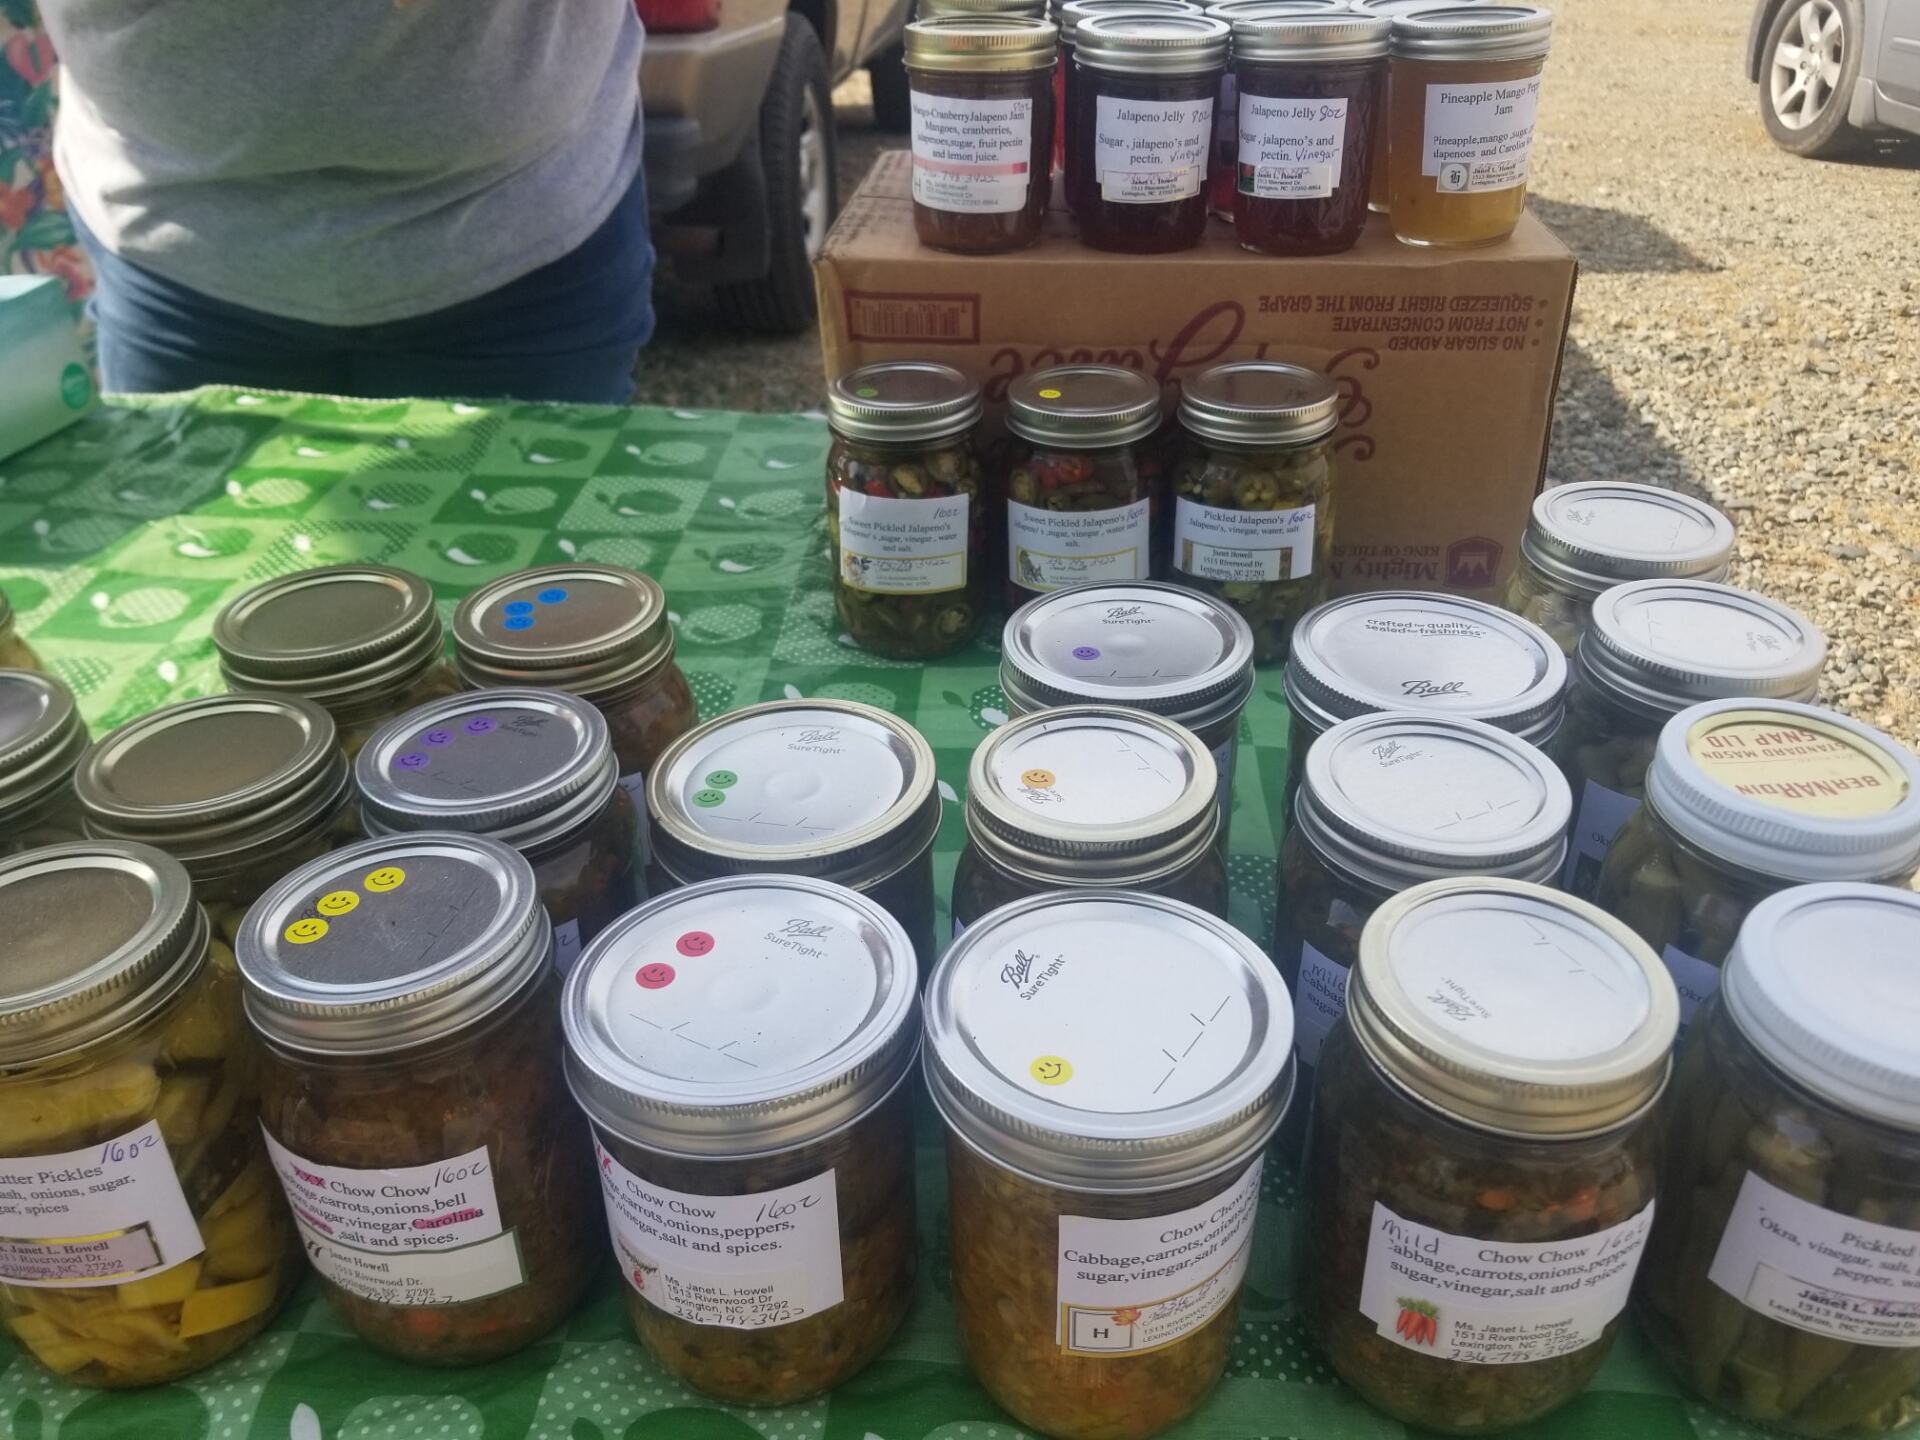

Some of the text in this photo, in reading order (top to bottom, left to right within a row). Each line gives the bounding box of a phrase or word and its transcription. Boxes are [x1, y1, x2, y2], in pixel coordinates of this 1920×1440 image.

[1441, 86, 1526, 105] Pineapple Mango
[1009, 110, 1025, 120] Jam
[1117, 109, 1185, 124] Jalapeno Jelly
[1250, 103, 1317, 121] Jalapeno Jelly
[1494, 105, 1513, 116] Jam
[962, 124, 1012, 135] cranberries,
[979, 139, 1022, 151] fruit pectin
[1185, 135, 1199, 147] and
[1316, 135, 1334, 146] and
[947, 150, 973, 161] lemon
[1261, 150, 1292, 161] pectin.
[1480, 146, 1497, 157] and
[1130, 154, 1163, 166] pectin.
[1259, 296, 1533, 312] SQUEEZED RIGHT FROM THE GRAPE
[1332, 316, 1529, 332] NOT FROM CONCENTRATE
[1388, 336, 1525, 350] NO SUGAR ADDED
[1048, 518, 1080, 527] Pickled
[1082, 514, 1124, 528] Jalapeno's
[1204, 510, 1284, 528] Pickled Jalapeno's
[874, 522, 905, 533] Pickled
[908, 522, 950, 535] Jalapeno's
[1213, 549, 1252, 559] Janet Howell
[1107, 606, 1144, 619] Ball
[1365, 624, 1406, 633] sealed
[1367, 619, 1412, 628] crafted
[1401, 680, 1472, 698] Ball
[1706, 730, 1817, 748] SNAP LID
[1371, 740, 1402, 760] Ball
[1702, 742, 1847, 760] STANDARD MASON
[1736, 775, 1882, 799] BERNARDIN
[779, 919, 833, 937] Ball
[1001, 949, 1034, 990] Ball
[1020, 957, 1066, 1001] SureTight
[37, 1167, 103, 1185] Pickles
[435, 1162, 487, 1188] 16oz
[31, 1187, 85, 1200] onions,
[88, 1175, 136, 1192] sugar,
[330, 1181, 430, 1199] Chow Chow
[626, 1180, 664, 1207] Chow
[669, 1200, 716, 1219] Chow
[24, 1204, 70, 1216] spices
[1160, 1220, 1206, 1244] Chow
[1221, 1220, 1240, 1246] and
[1382, 1217, 1440, 1255] Mild
[1760, 1216, 1801, 1246] Okra,
[11, 1245, 44, 1255] Janet
[63, 1241, 109, 1254] Howell
[370, 1233, 459, 1248] and spices.
[1841, 1232, 1916, 1258] Pickled
[692, 1241, 782, 1256] and spices.
[1478, 1247, 1590, 1265] Chow Chow
[354, 1257, 389, 1272] Howell
[1833, 1267, 1894, 1287] pepper,
[686, 1283, 715, 1295] Janet
[734, 1285, 774, 1296] Howell
[1550, 1278, 1581, 1295] and
[695, 1295, 754, 1305] Riverwood
[1798, 1289, 1848, 1310] Janet
[726, 1306, 744, 1314] NC
[1481, 1318, 1574, 1333] Janet Howell
[1093, 1328, 1108, 1339] H
[1454, 1330, 1485, 1341] 1513
[1489, 1331, 1551, 1341] Riverwood
[1519, 1341, 1537, 1349] NC
